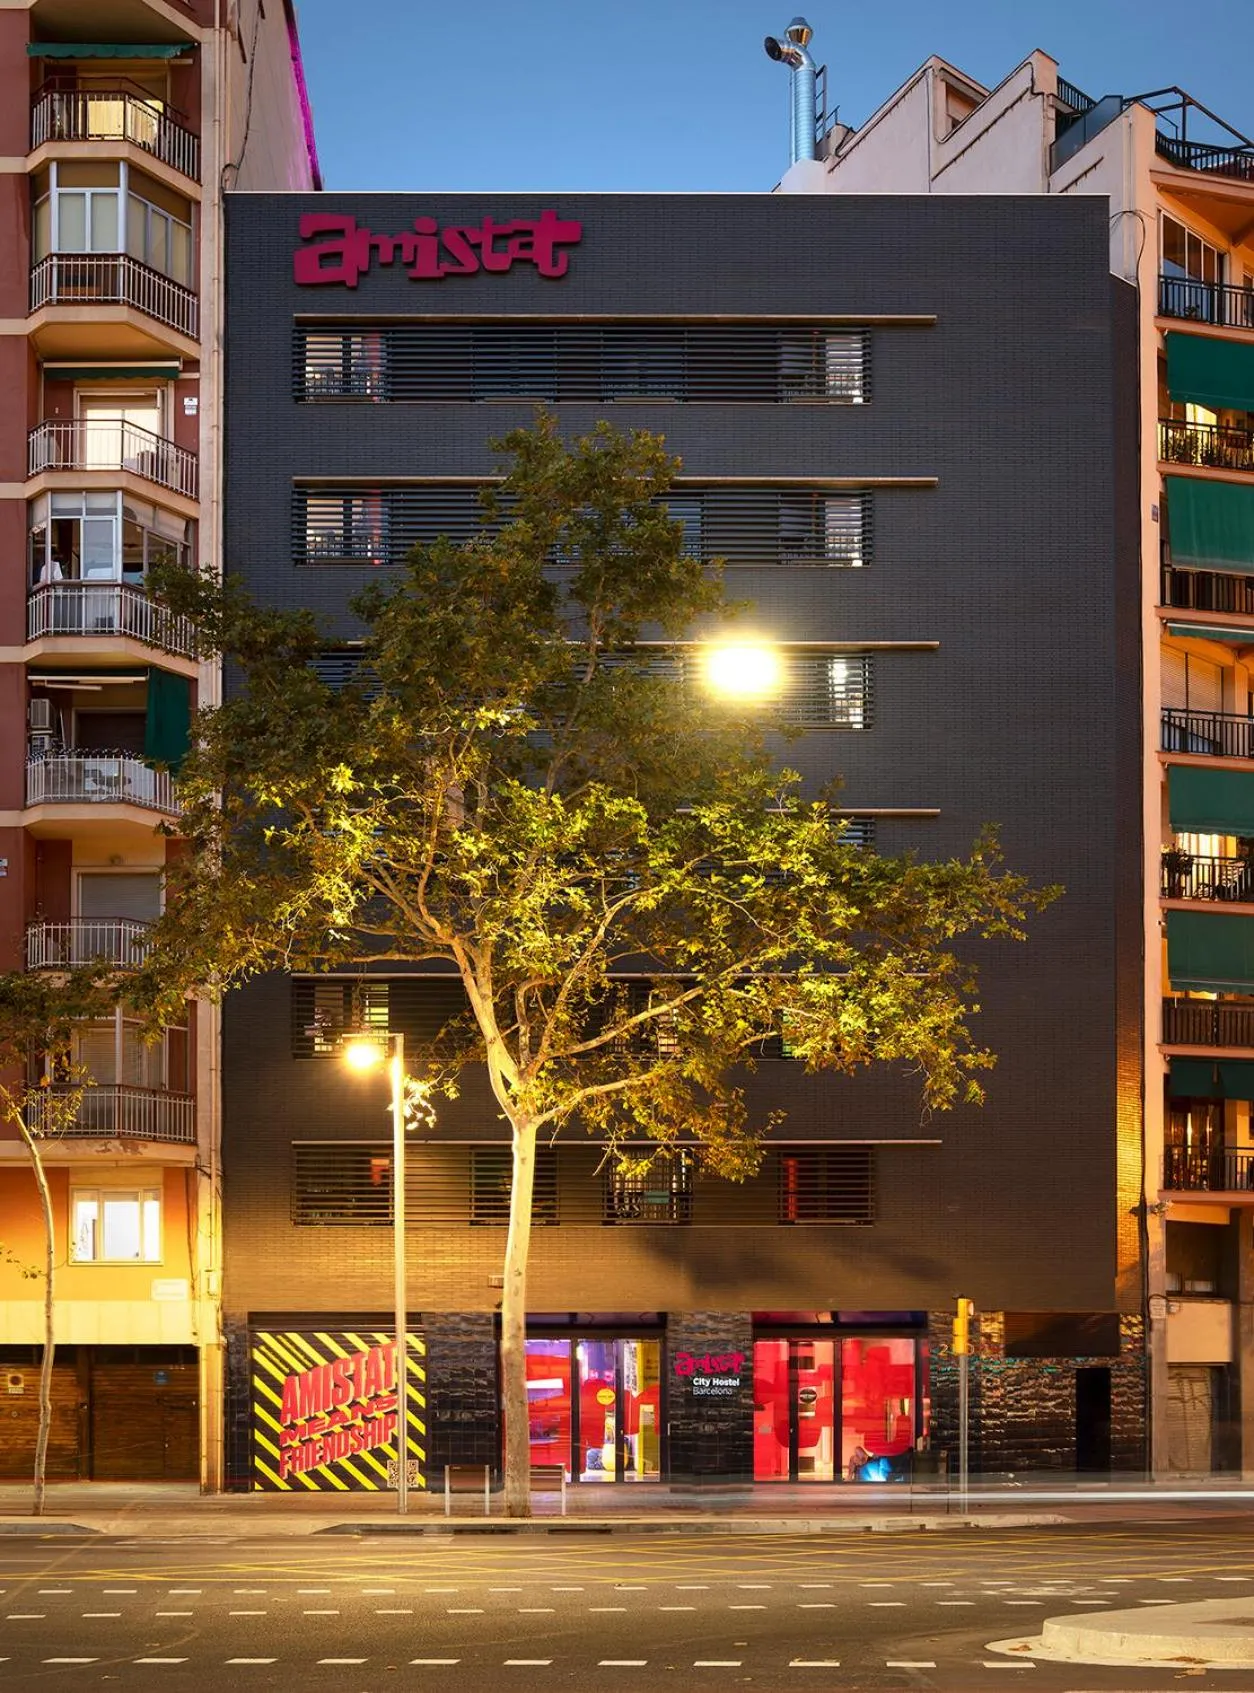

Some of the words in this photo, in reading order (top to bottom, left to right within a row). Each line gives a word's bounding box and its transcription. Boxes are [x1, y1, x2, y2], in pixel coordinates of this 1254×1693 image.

[293, 209, 583, 288] amistat
[281, 1340, 398, 1425] AMISTAT
[693, 1378, 710, 1387] City
[712, 1378, 740, 1386] Hostel
[693, 1387, 733, 1395] Barcelona
[279, 1393, 398, 1446] MEANS
[279, 1412, 398, 1480] FRIENDSHIP
